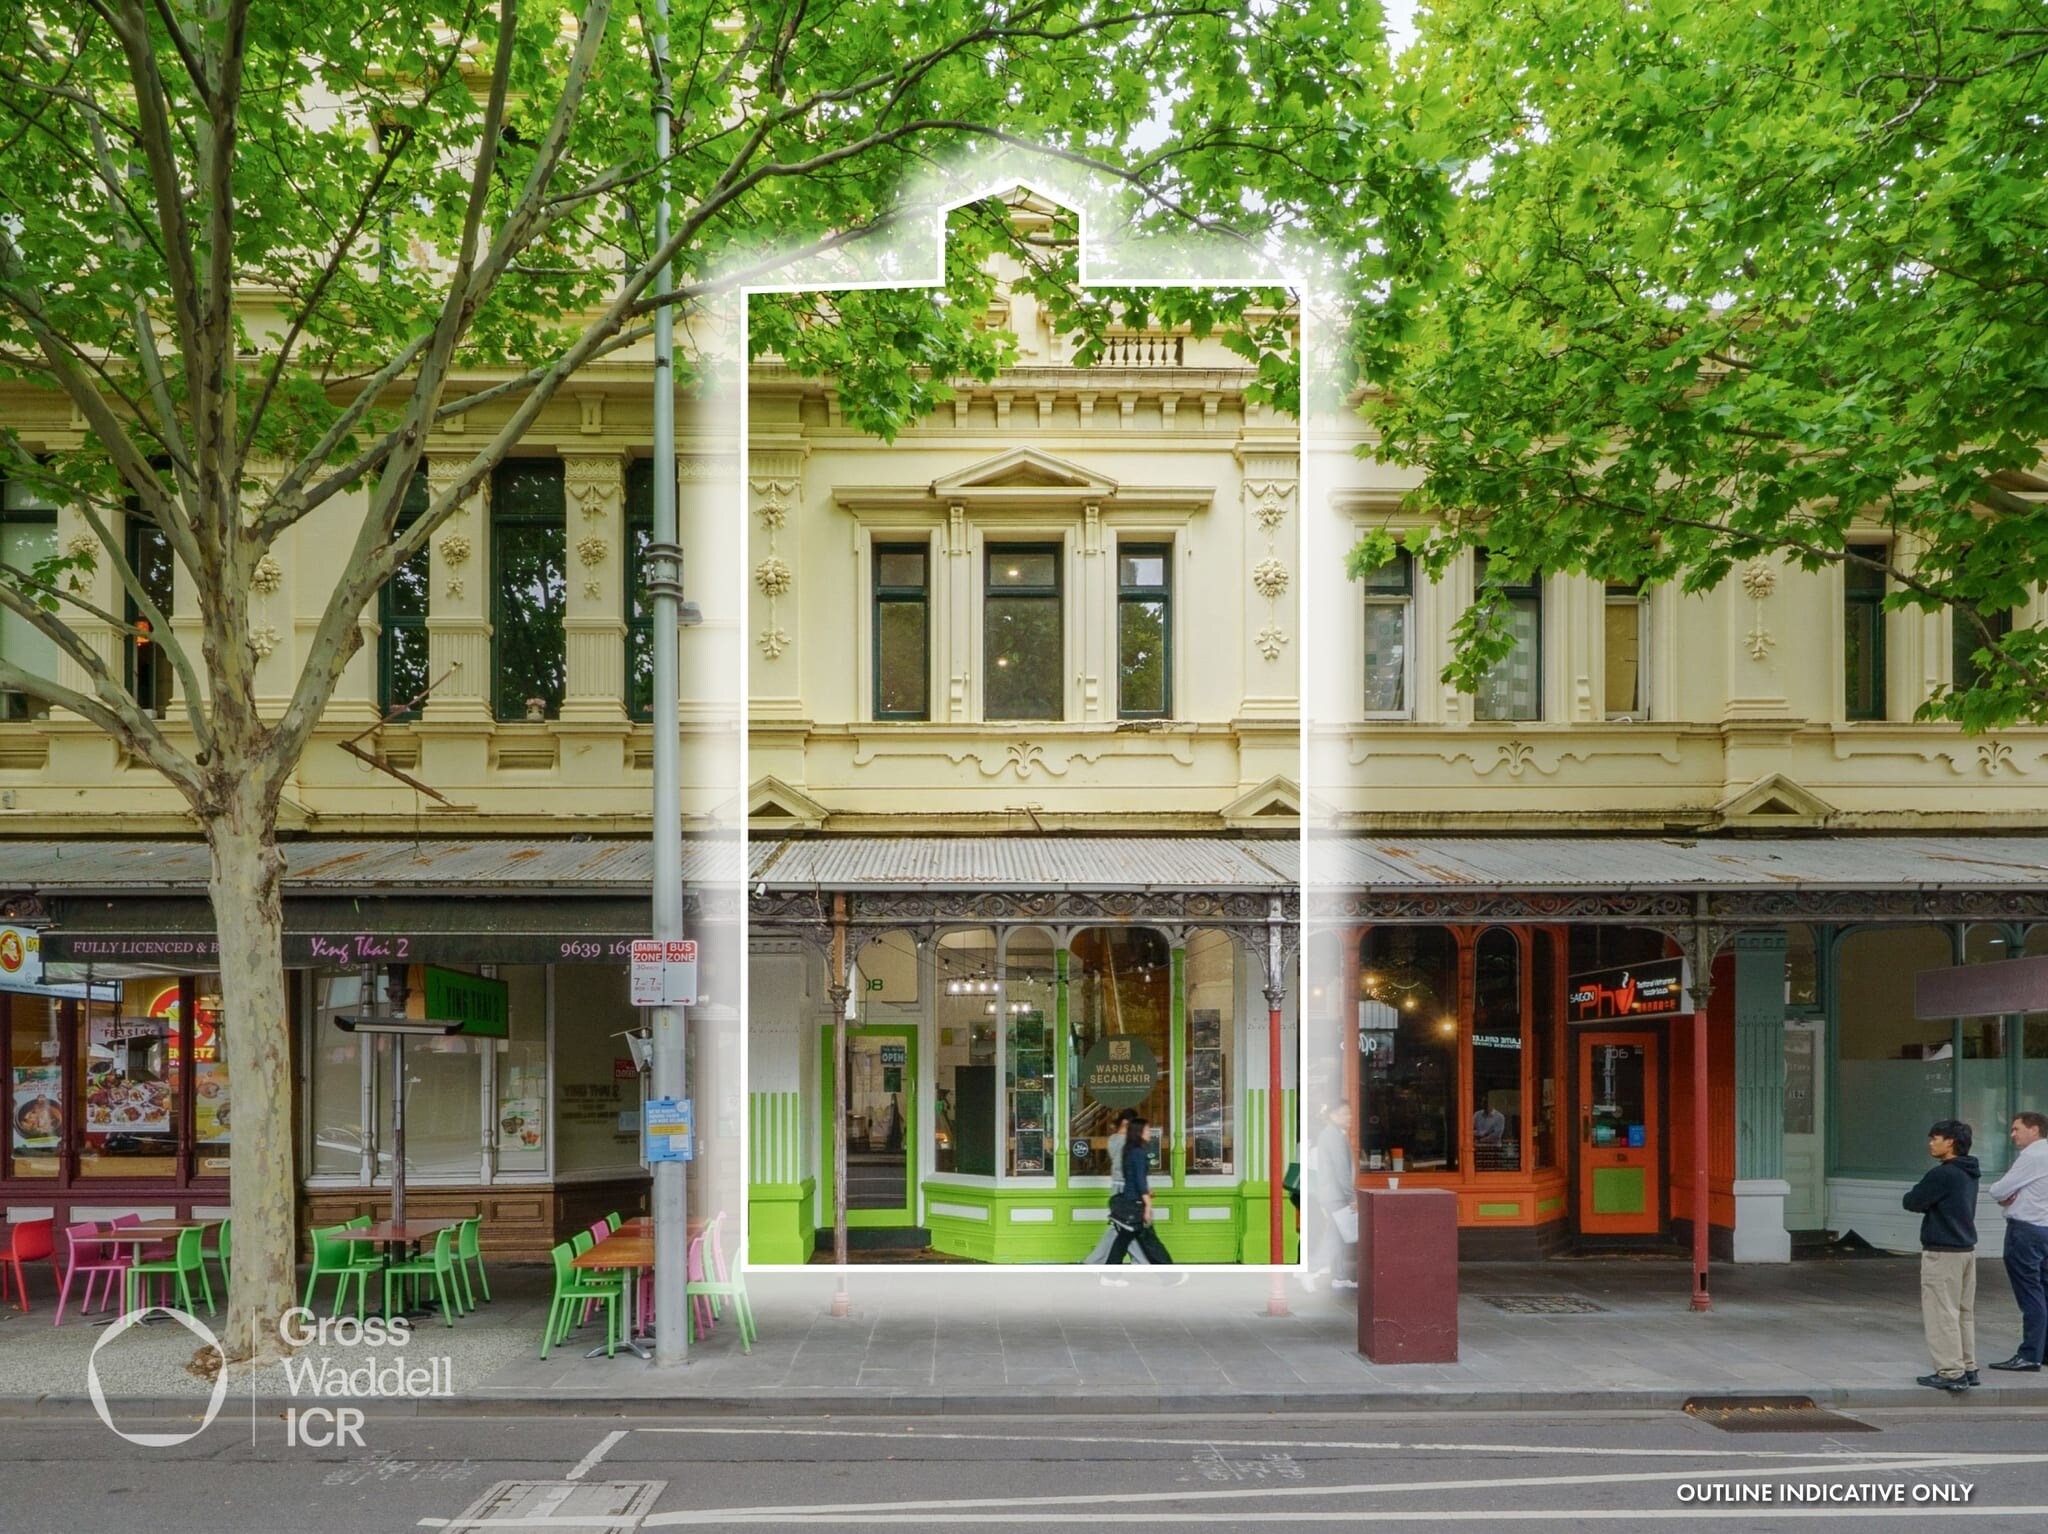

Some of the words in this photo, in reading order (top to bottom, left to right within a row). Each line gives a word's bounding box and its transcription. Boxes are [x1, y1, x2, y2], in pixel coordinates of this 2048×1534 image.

[73, 941, 118, 953] FULLY
[122, 941, 193, 953] LICENCED
[197, 941, 207, 953] &
[311, 937, 349, 964] Ying
[354, 936, 391, 956] Thai
[396, 938, 409, 958] 2
[560, 940, 601, 958] 9639
[607, 940, 632, 958] 169
[634, 943, 662, 952] LOADING
[670, 943, 692, 952] BUS
[634, 953, 662, 962] ZONE
[667, 953, 695, 962] ZONE
[882, 1053, 904, 1062] OPEN
[1096, 1064, 1144, 1073] WARISAN
[1090, 1074, 1151, 1084] SECANGKIR
